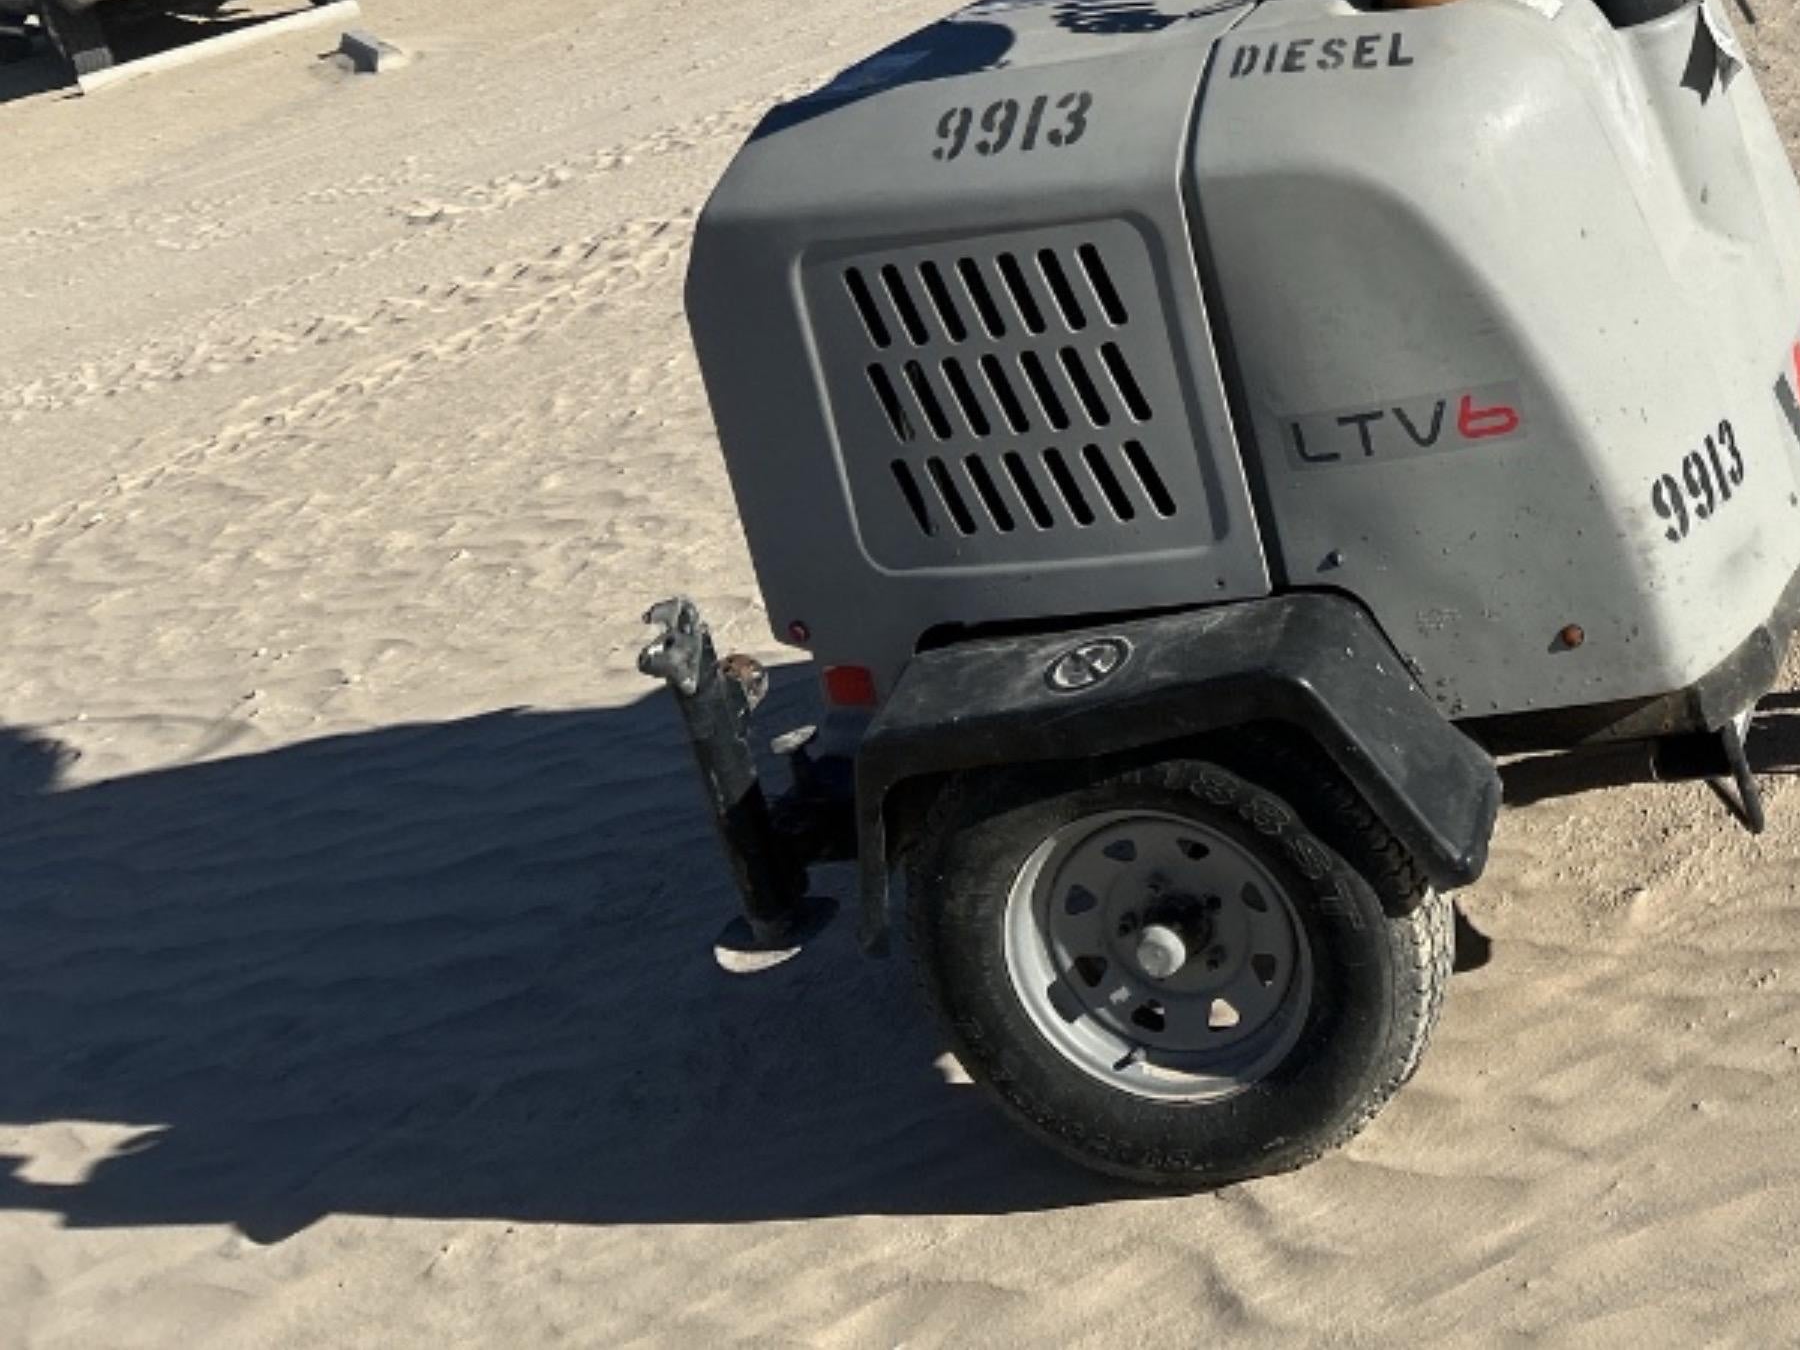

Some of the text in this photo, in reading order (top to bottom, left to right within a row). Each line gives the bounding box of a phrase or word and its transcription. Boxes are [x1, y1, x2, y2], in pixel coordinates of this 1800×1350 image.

[1229, 32, 1415, 79] DIESEL
[932, 90, 1093, 161] 9913
[1290, 394, 1519, 463] LTV6
[1650, 418, 1746, 543] 9913
